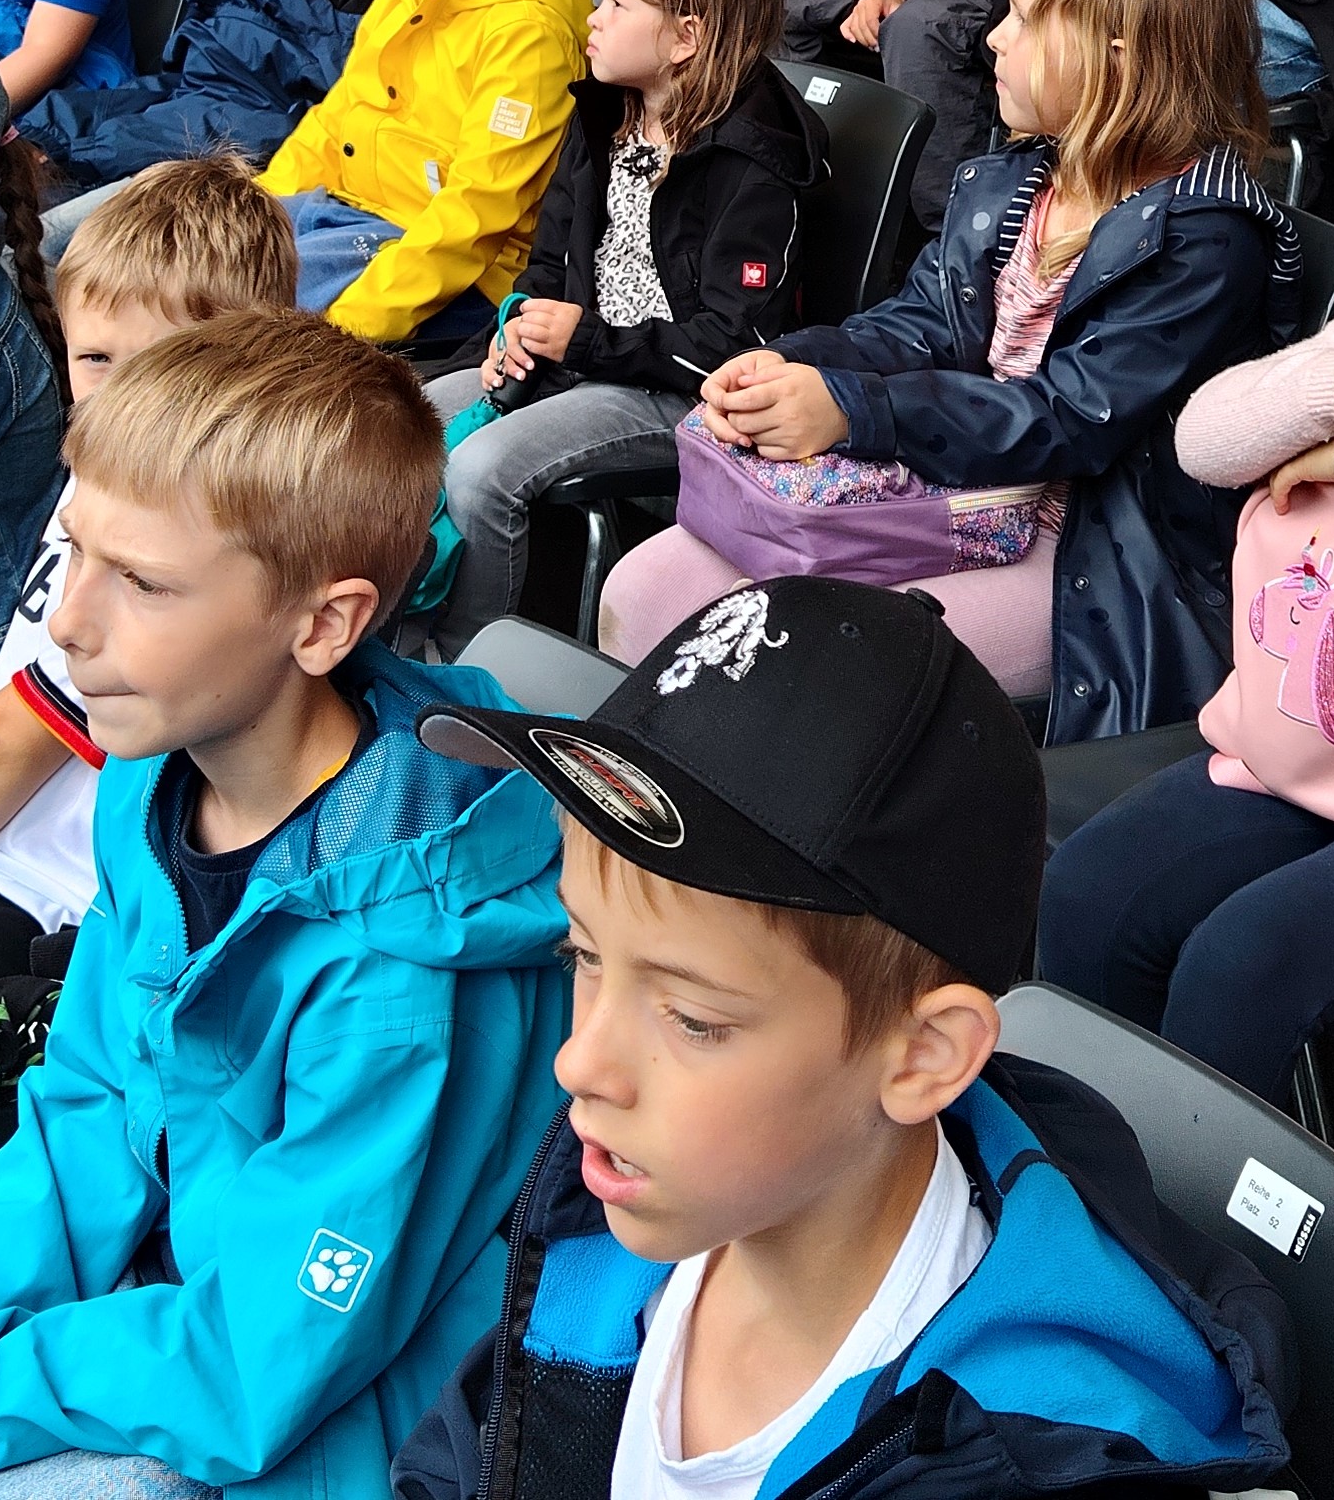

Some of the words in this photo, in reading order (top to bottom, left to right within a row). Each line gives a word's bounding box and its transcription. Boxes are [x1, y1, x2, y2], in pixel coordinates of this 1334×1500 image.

[576, 766, 612, 798] YOUTH
[1247, 1179, 1271, 1200] Reihe
[1275, 1198, 1284, 1208] 2
[1240, 1197, 1261, 1216] Platz
[1268, 1216, 1280, 1230] 52
